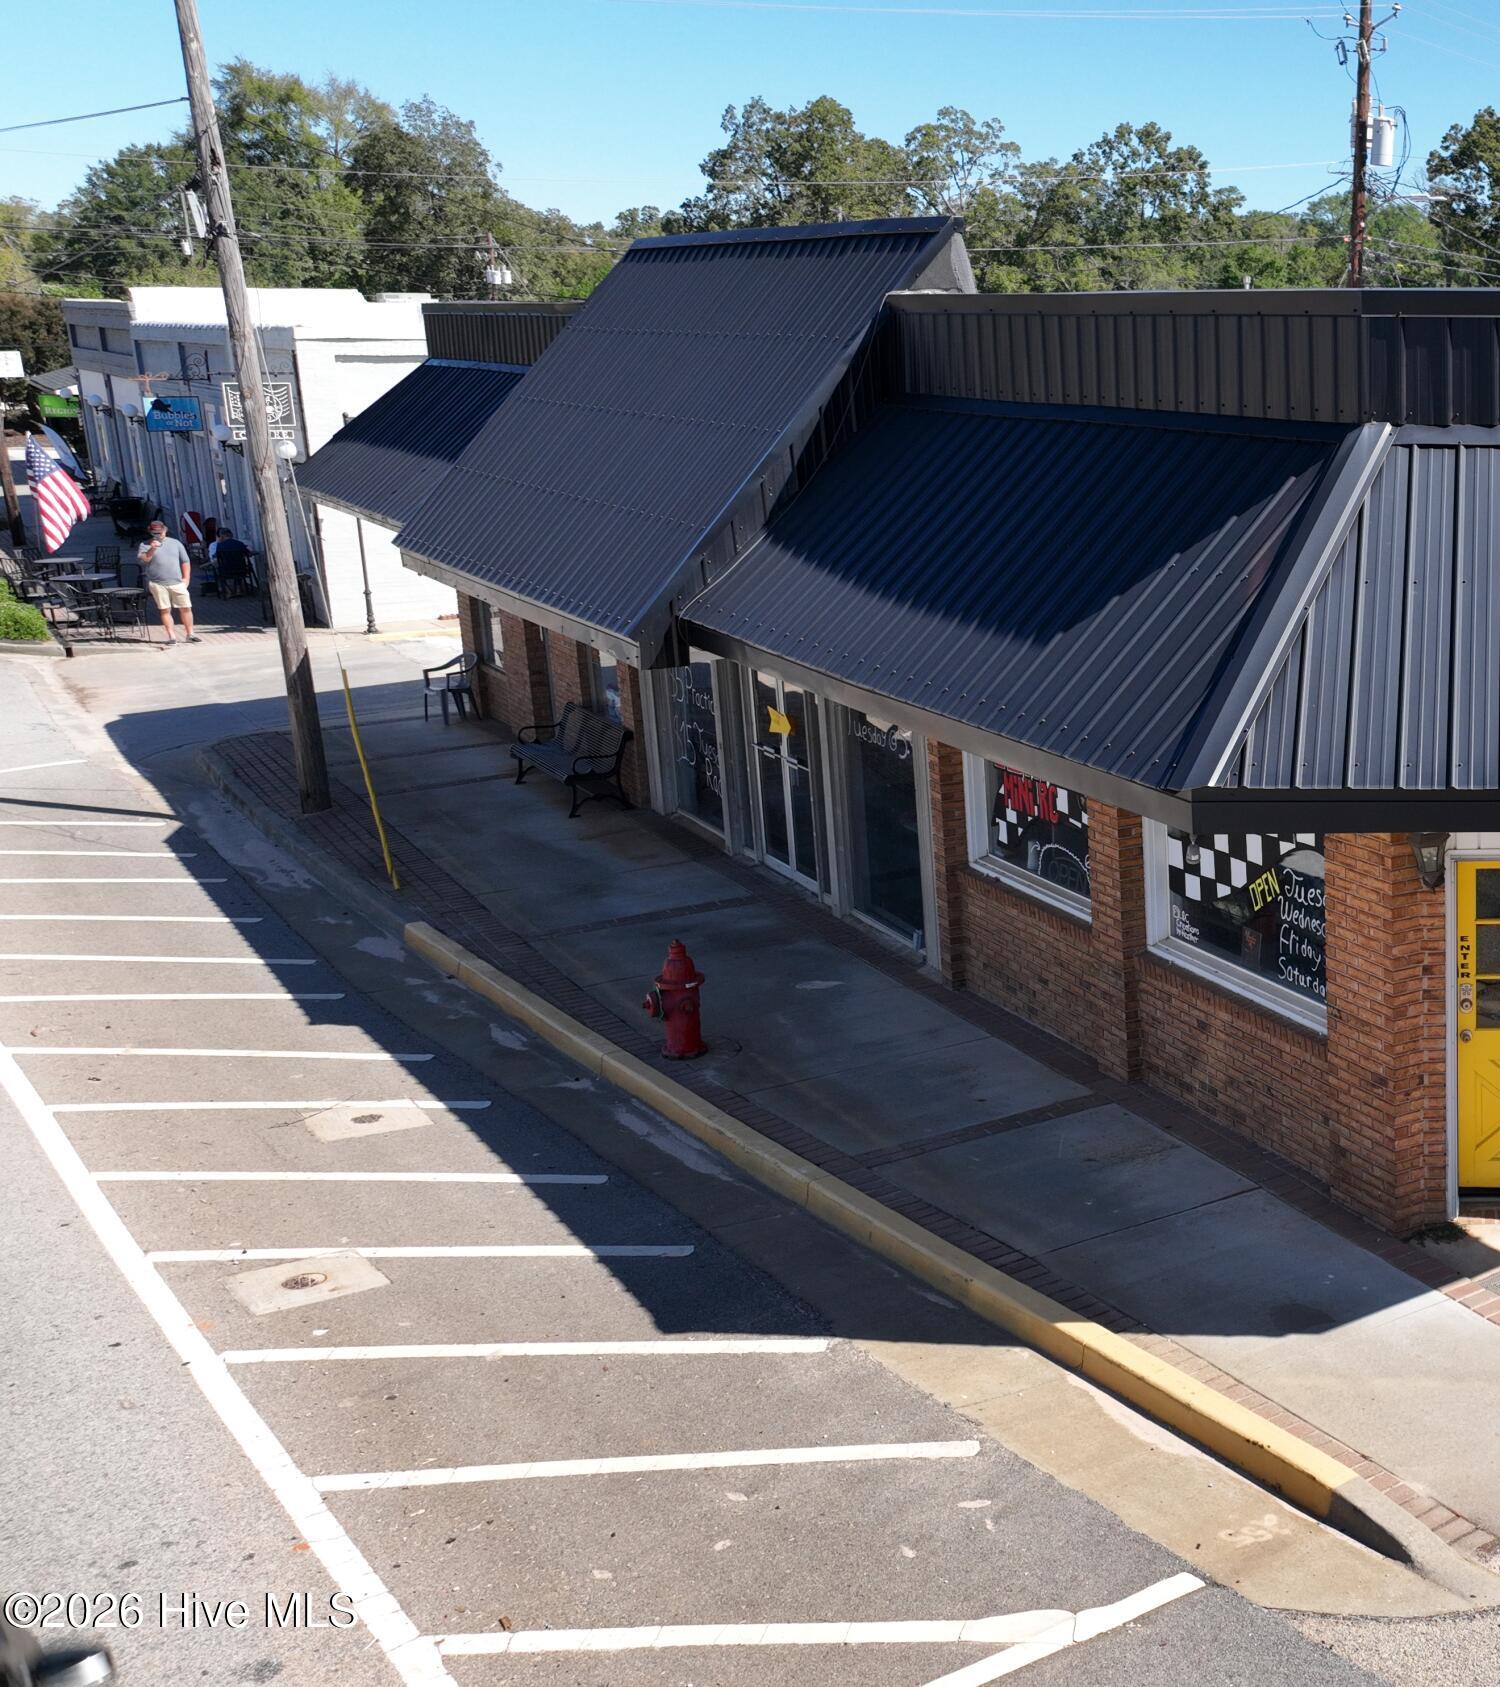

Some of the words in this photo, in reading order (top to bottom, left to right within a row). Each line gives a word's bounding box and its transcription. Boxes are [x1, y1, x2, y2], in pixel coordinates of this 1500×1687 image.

[152, 410, 196, 420] Bubbles
[174, 418, 193, 427] Not
[1037, 781, 1062, 825] RC
[1248, 868, 1281, 912] OPEN
[1282, 868, 1326, 907] Tues
[1279, 923, 1322, 972] Friday
[1459, 935, 1471, 979] ENTER
[1278, 956, 1327, 1003] Saturda
